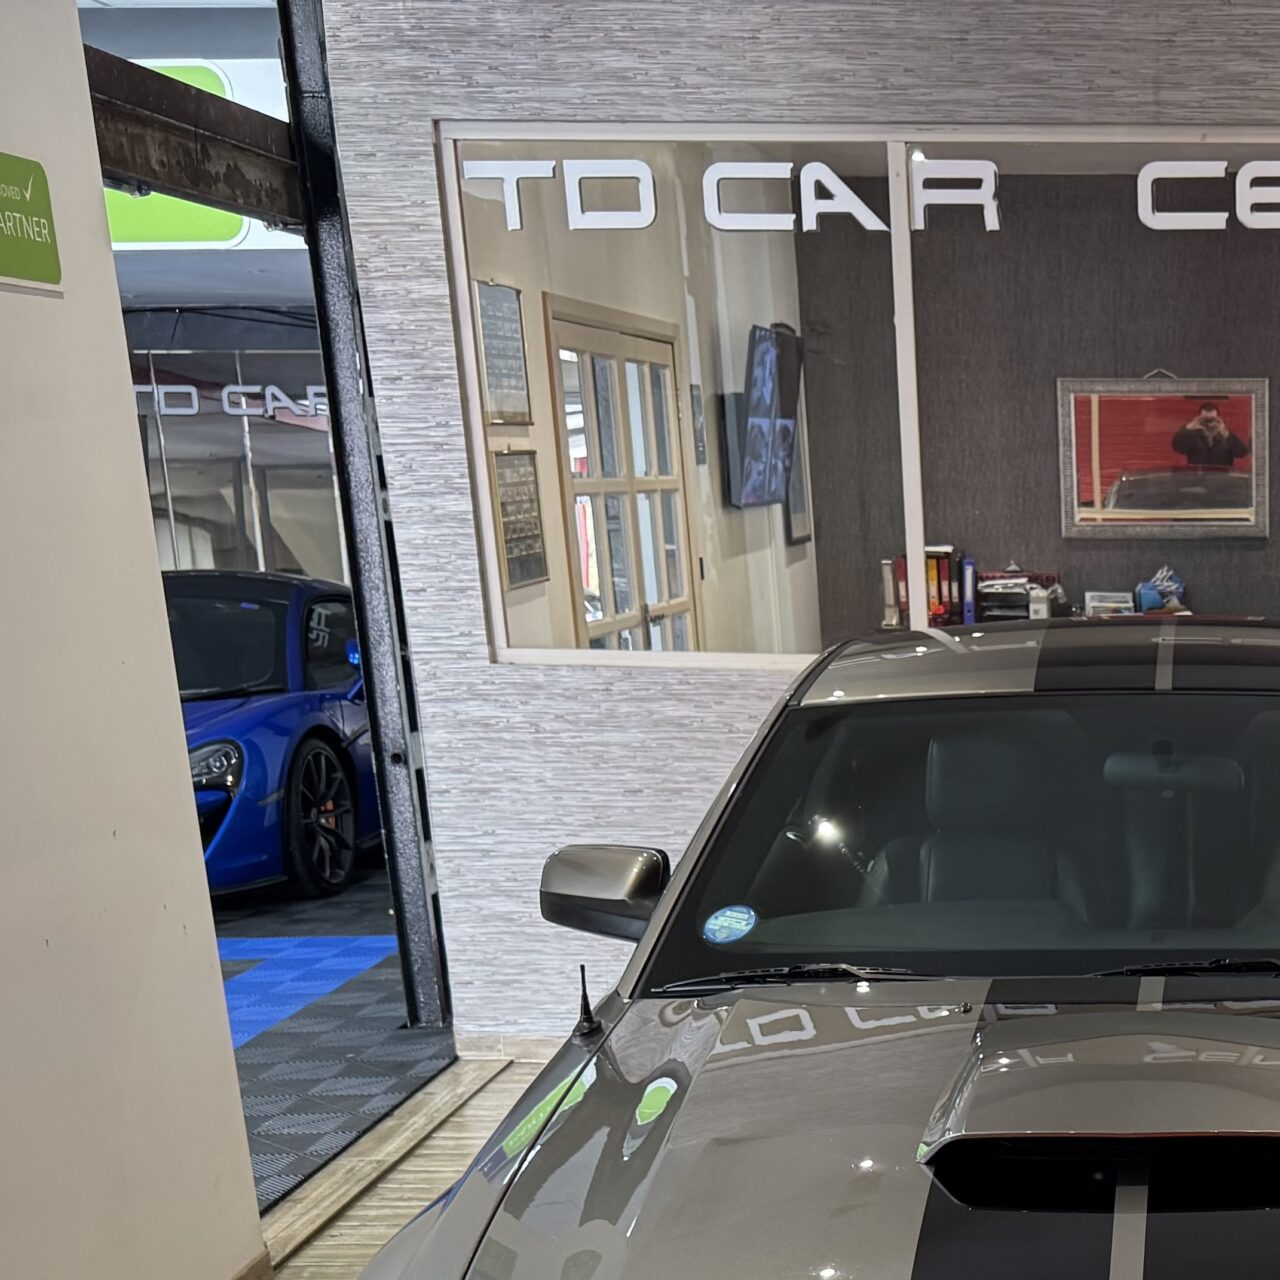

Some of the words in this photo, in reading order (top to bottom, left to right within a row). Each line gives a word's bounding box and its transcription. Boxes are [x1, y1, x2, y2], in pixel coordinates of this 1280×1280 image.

[0, 184, 20, 200] OVED
[463, 158, 656, 231] TD
[702, 159, 1000, 233] CAR
